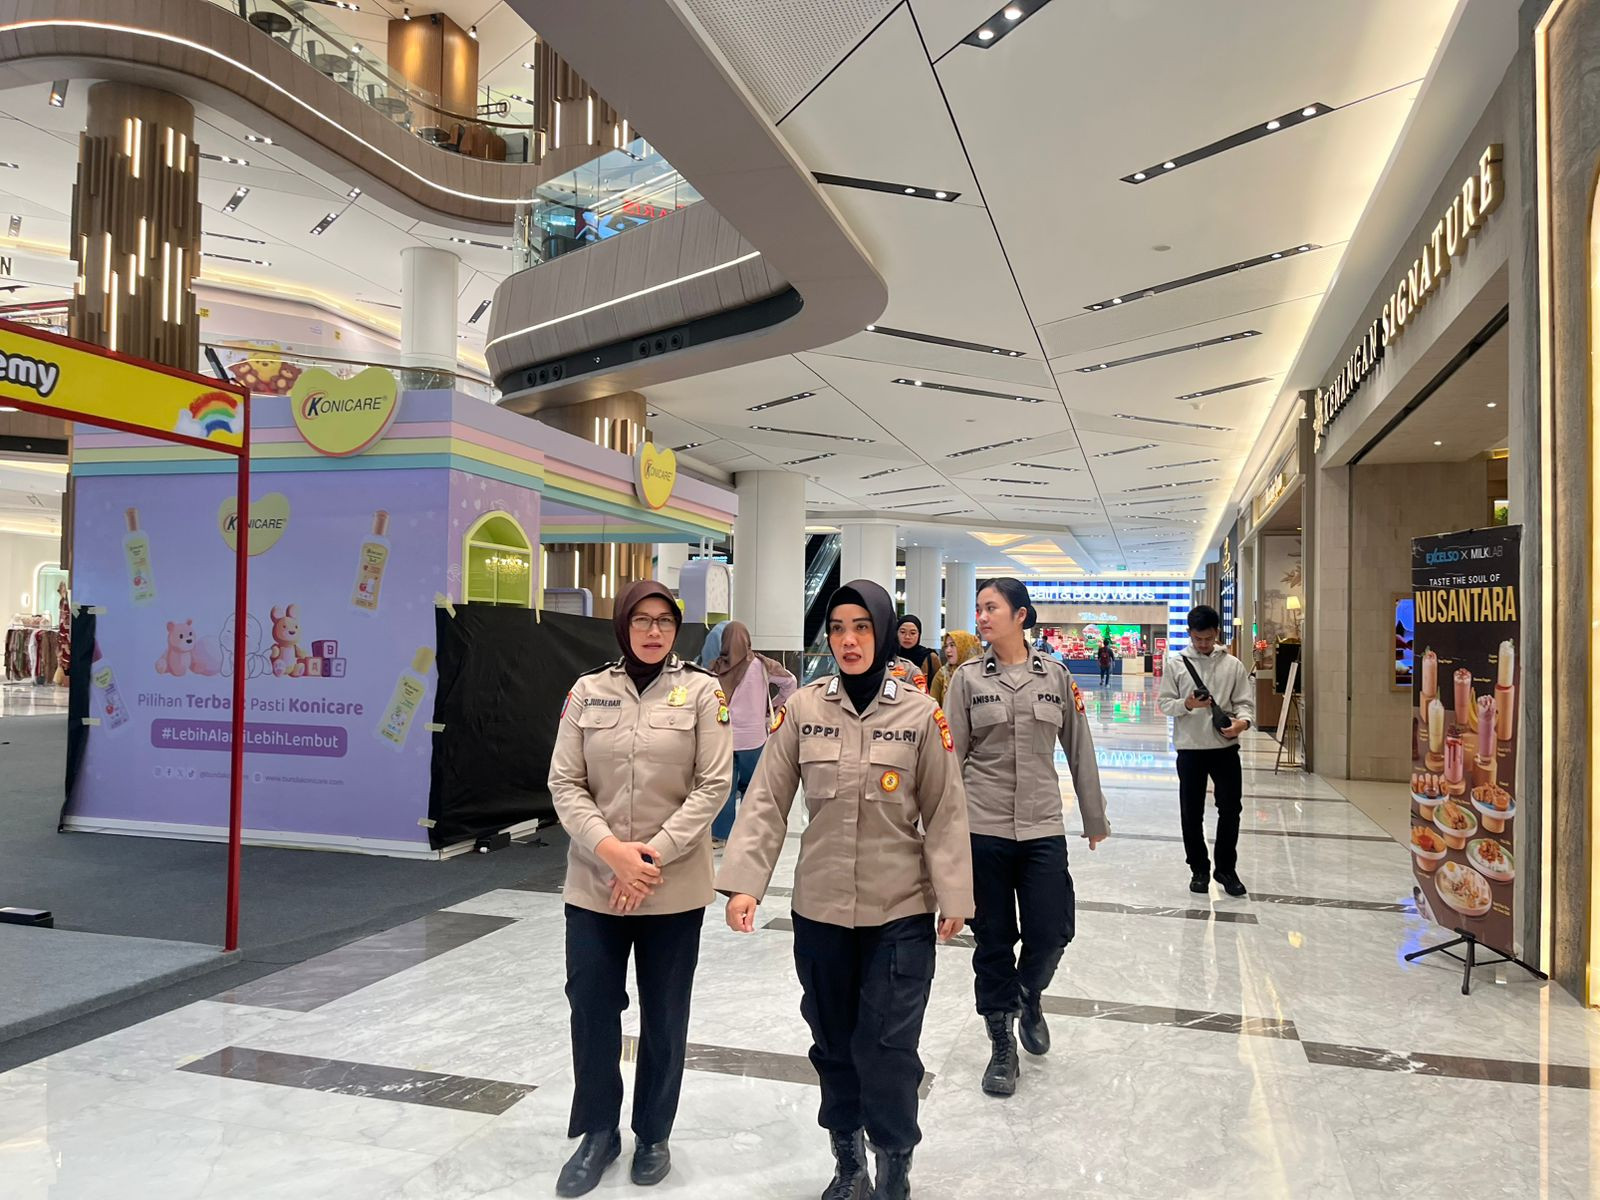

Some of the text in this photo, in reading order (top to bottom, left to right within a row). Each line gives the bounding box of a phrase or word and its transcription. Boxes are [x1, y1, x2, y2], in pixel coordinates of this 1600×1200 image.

[1324, 143, 1504, 427] KENANGAN SIGNATURE
[307, 396, 382, 416] KONICARE
[227, 515, 283, 531] KNICARE
[1429, 573, 1501, 587] TASTE THE SOUL OF
[1415, 585, 1517, 623] NUSANTARA
[138, 693, 364, 716] Pilihan Terba Pasti Konicare
[972, 694, 1001, 705] ANISSA
[161, 727, 339, 749] #LebihAlaiLebihLembut
[801, 724, 840, 737] OPPI
[872, 730, 916, 743] POLRI
